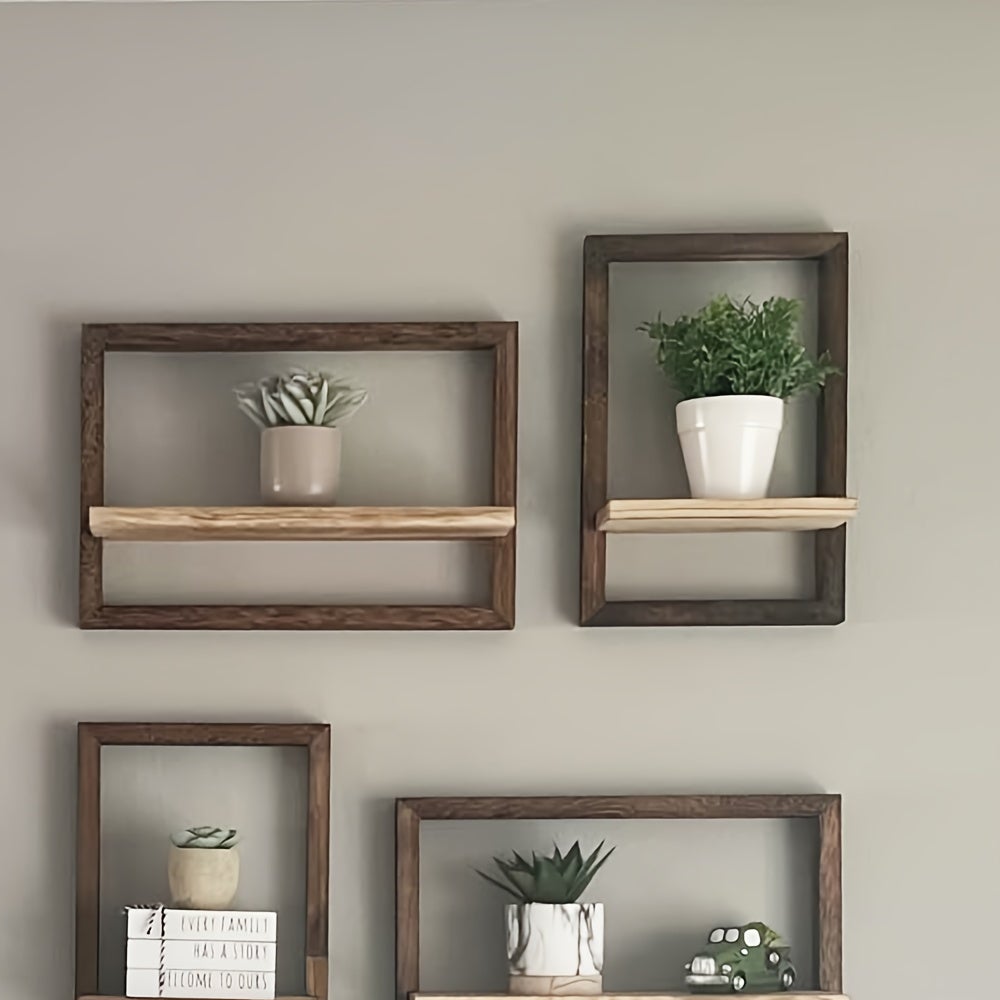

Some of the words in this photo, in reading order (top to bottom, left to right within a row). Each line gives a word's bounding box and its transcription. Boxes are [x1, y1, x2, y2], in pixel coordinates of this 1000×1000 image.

[193, 943, 215, 959] HAS
[220, 943, 227, 959] A
[233, 943, 267, 960] STORY
[165, 971, 212, 989] ELCOME
[219, 972, 233, 989] TO
[238, 972, 267, 990] OURS
